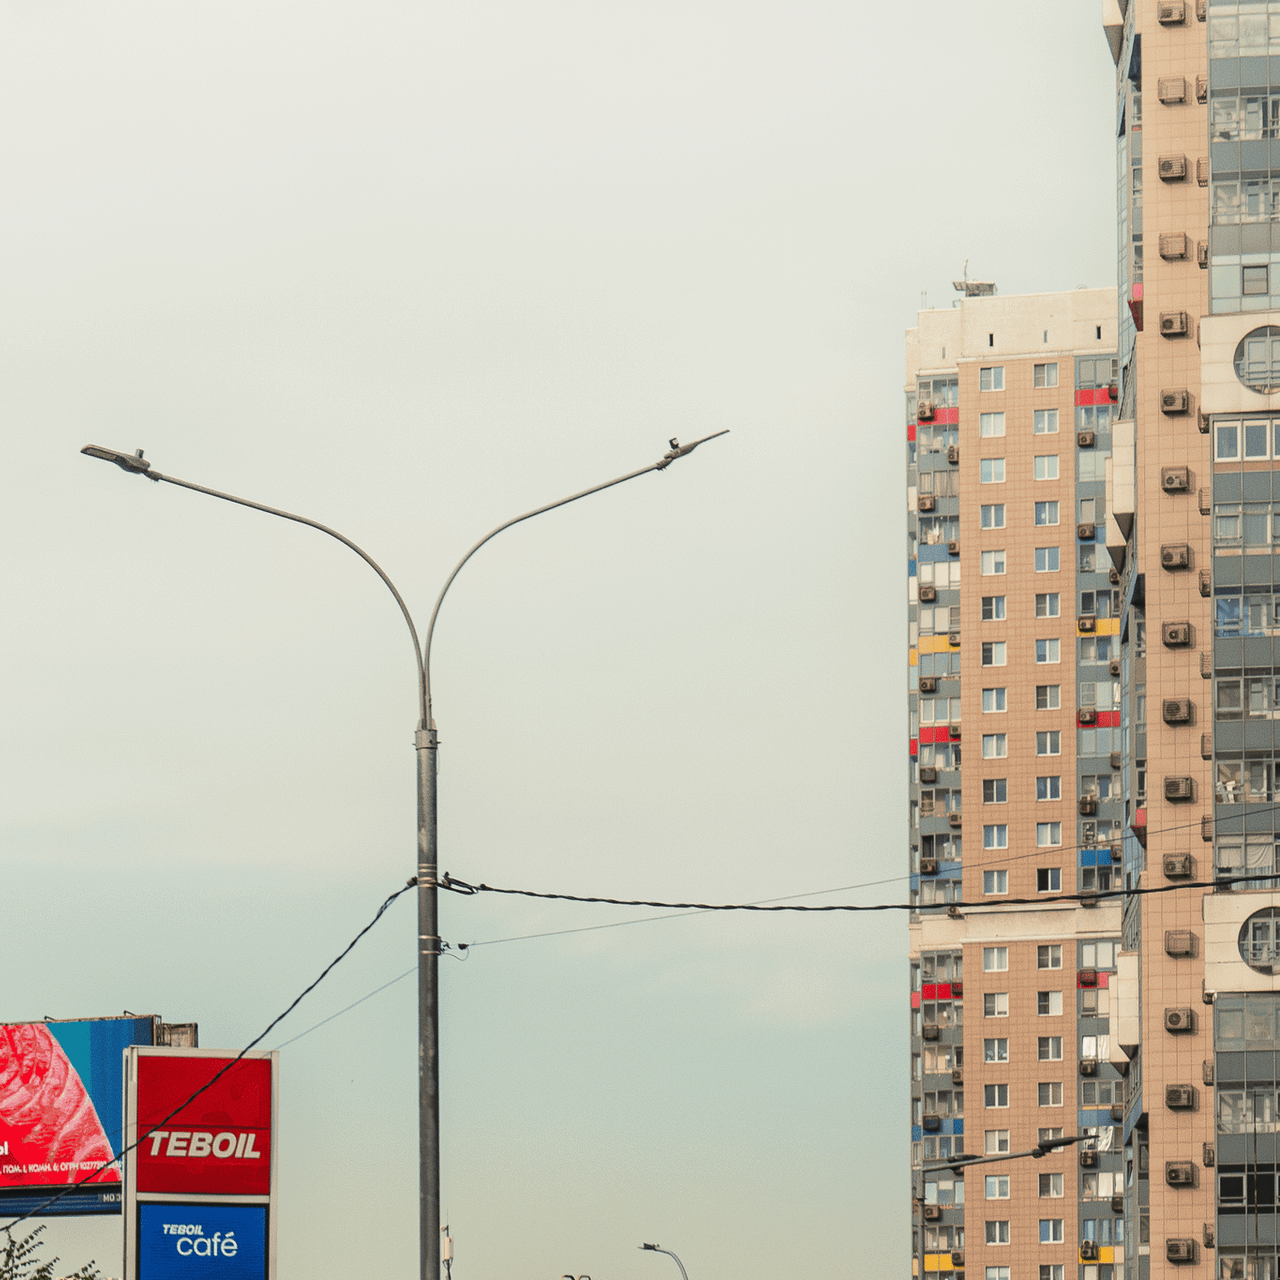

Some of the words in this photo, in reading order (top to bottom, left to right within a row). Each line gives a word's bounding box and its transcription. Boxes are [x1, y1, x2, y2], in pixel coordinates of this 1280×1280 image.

[148, 1131, 261, 1159] TEBOIL
[162, 1223, 204, 1235] TEBOIL
[176, 1231, 238, 1257] café
